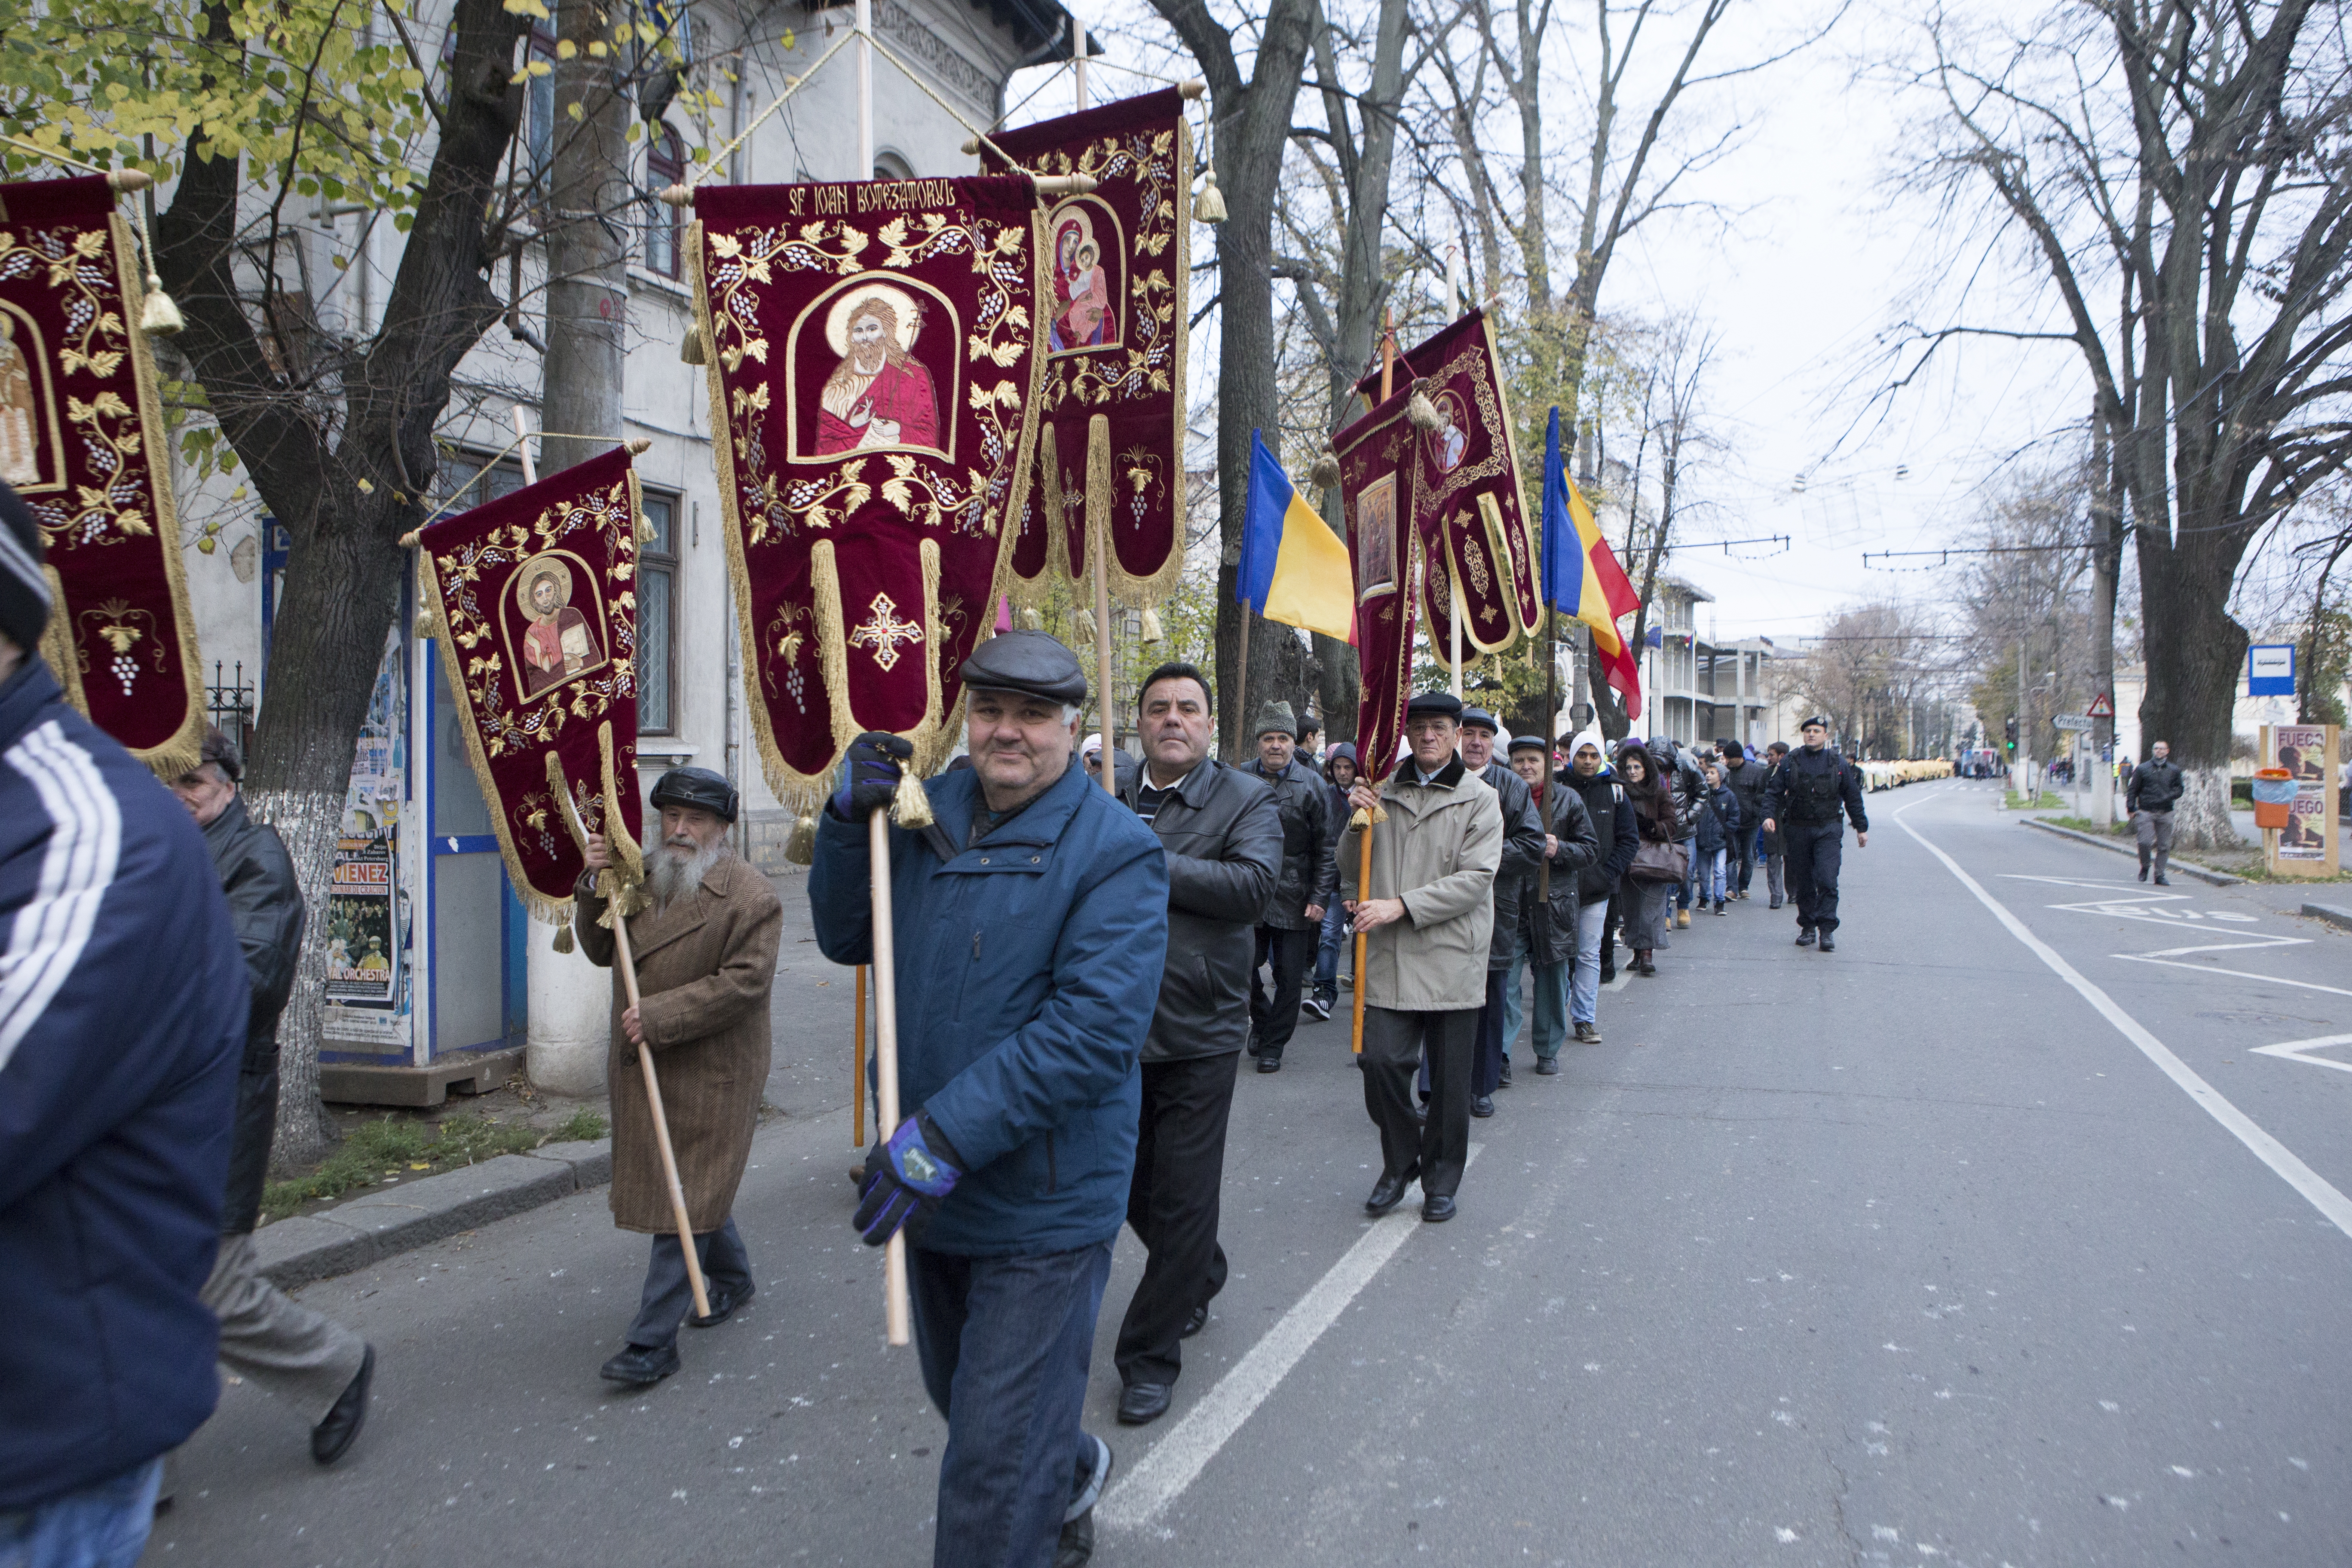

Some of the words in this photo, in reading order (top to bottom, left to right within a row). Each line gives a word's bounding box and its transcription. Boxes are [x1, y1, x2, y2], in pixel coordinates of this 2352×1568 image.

[789, 187, 805, 216] SF.
[815, 185, 848, 215] IOAN
[334, 864, 388, 882] VIENEZ
[2097, 904, 2260, 922] BUS
[343, 968, 390, 982] ORCHESTRA
